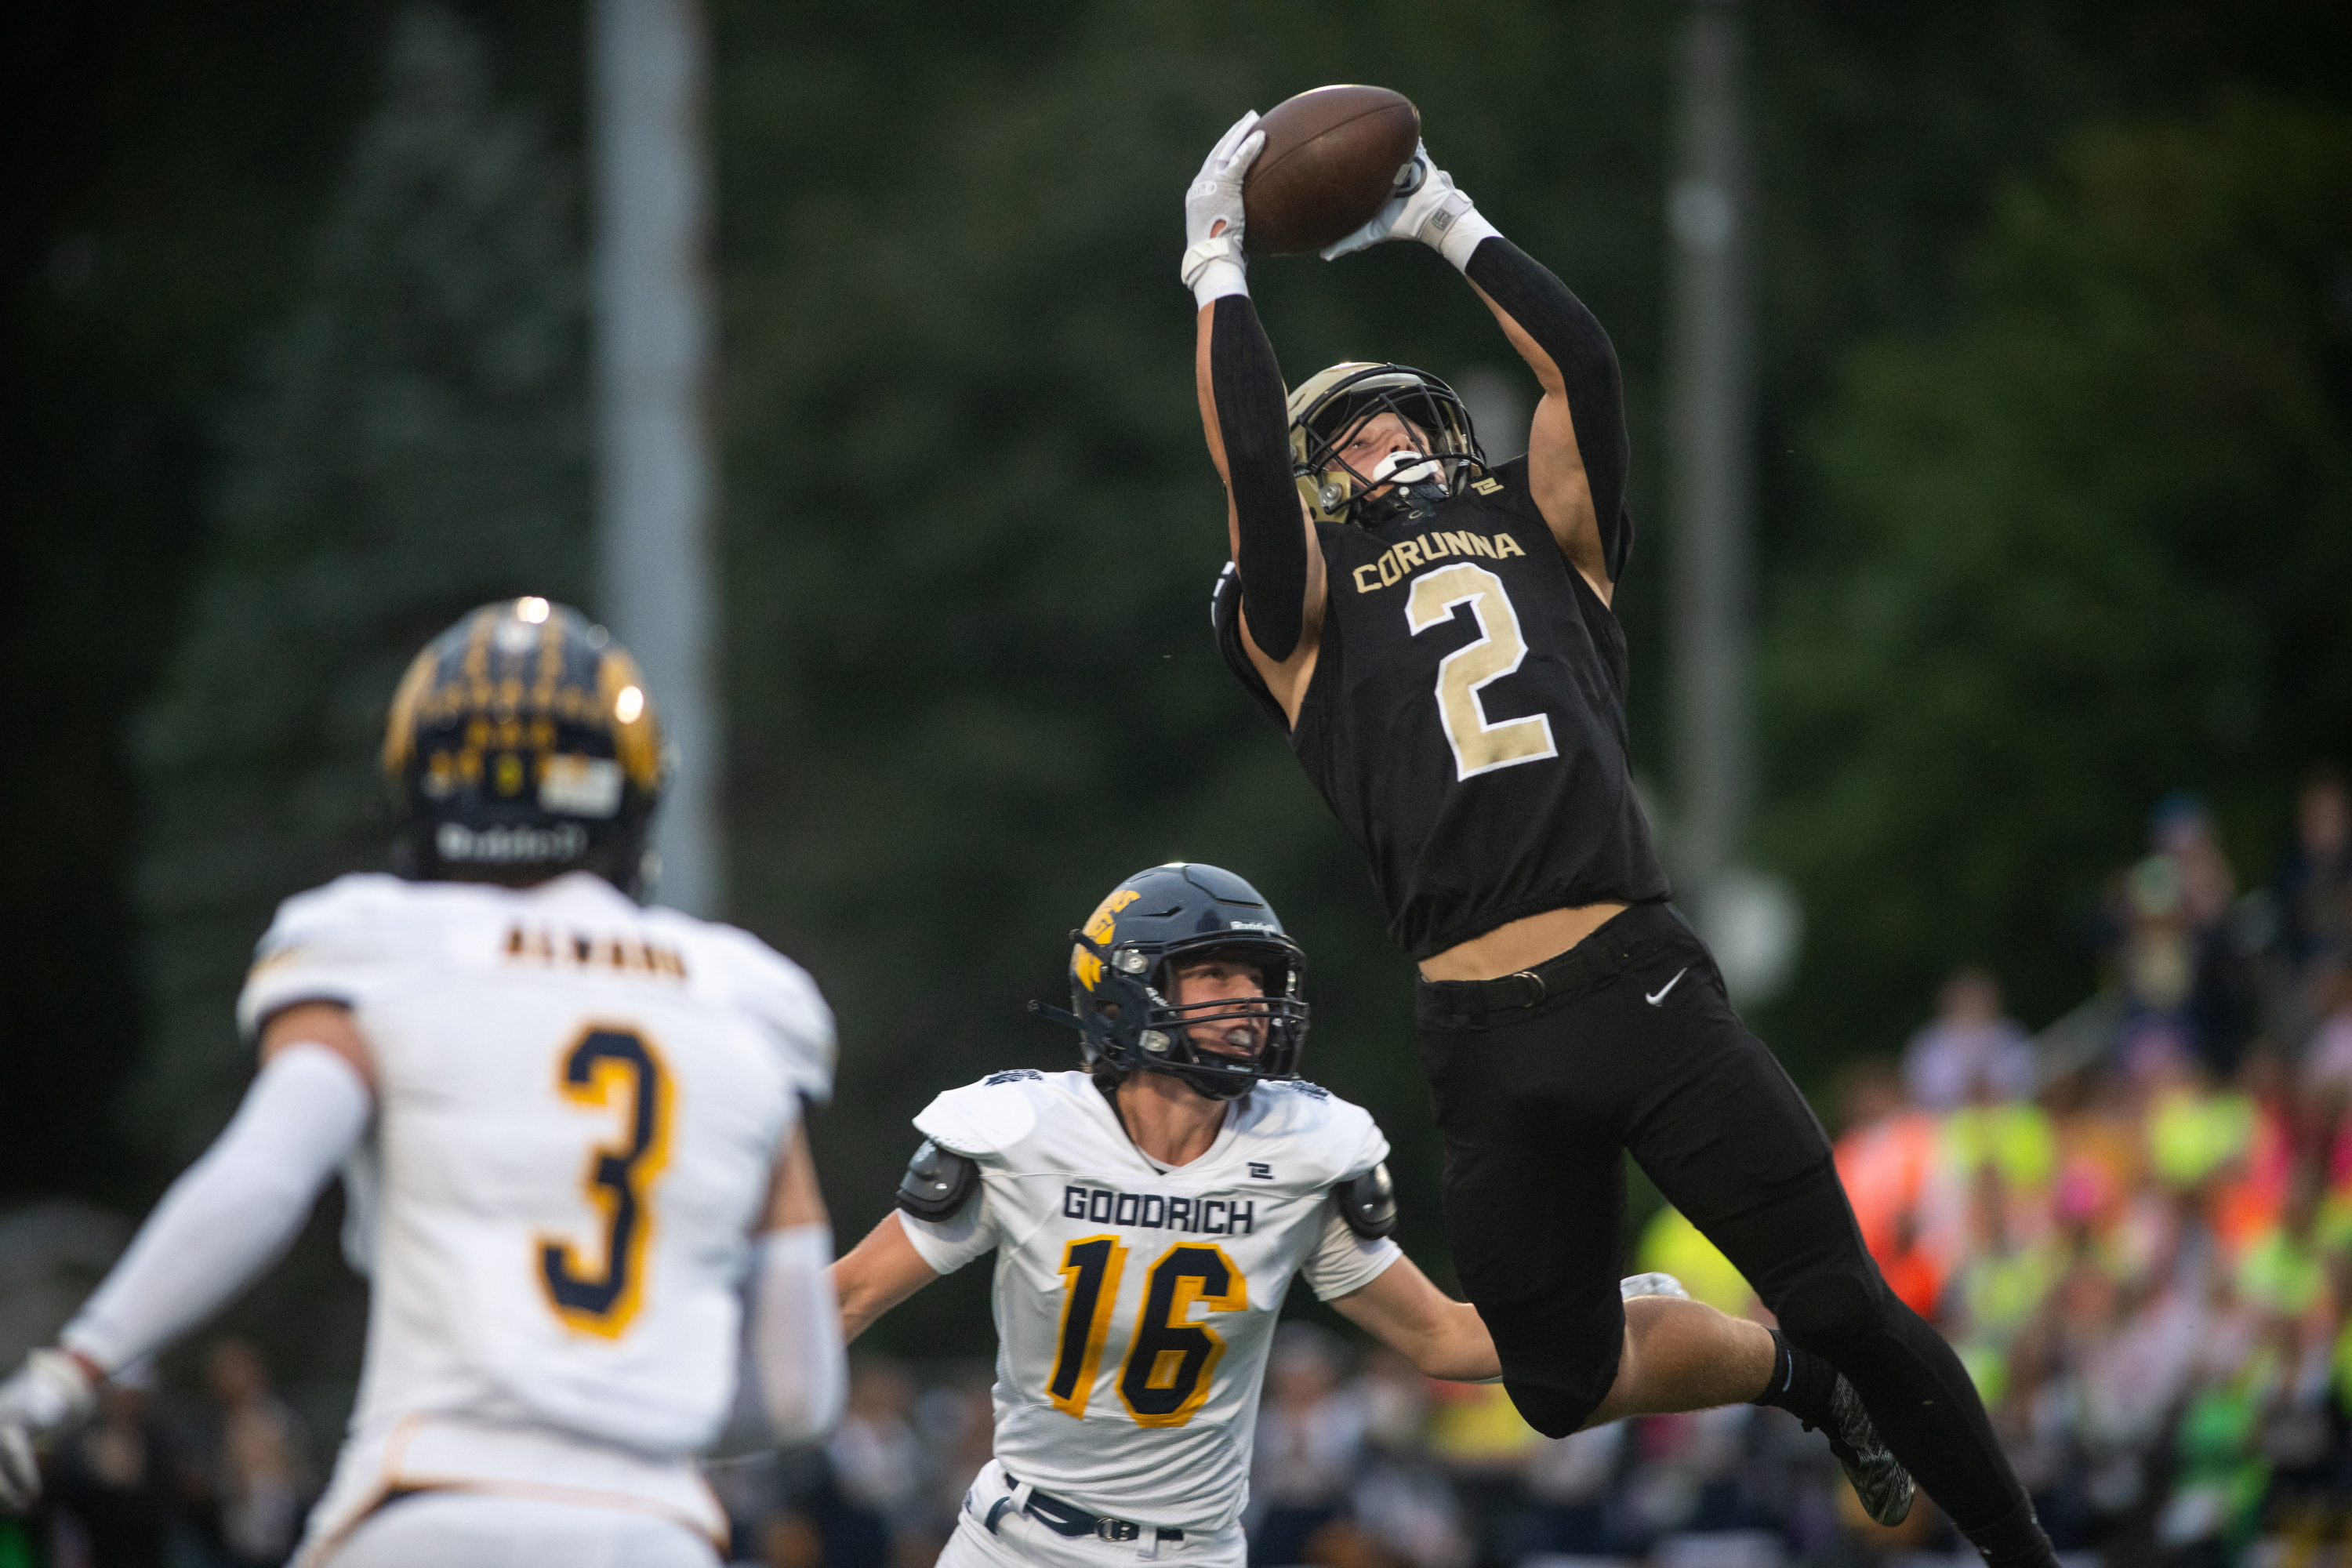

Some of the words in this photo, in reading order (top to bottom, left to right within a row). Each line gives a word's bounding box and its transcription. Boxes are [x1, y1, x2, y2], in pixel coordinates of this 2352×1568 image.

[1352, 530, 1526, 593] CORUNNA
[1404, 561, 1559, 782] 2
[534, 1018, 678, 1341] 3
[1063, 1185, 1254, 1235] GOODRICH
[1045, 1234, 1248, 1428] 16
